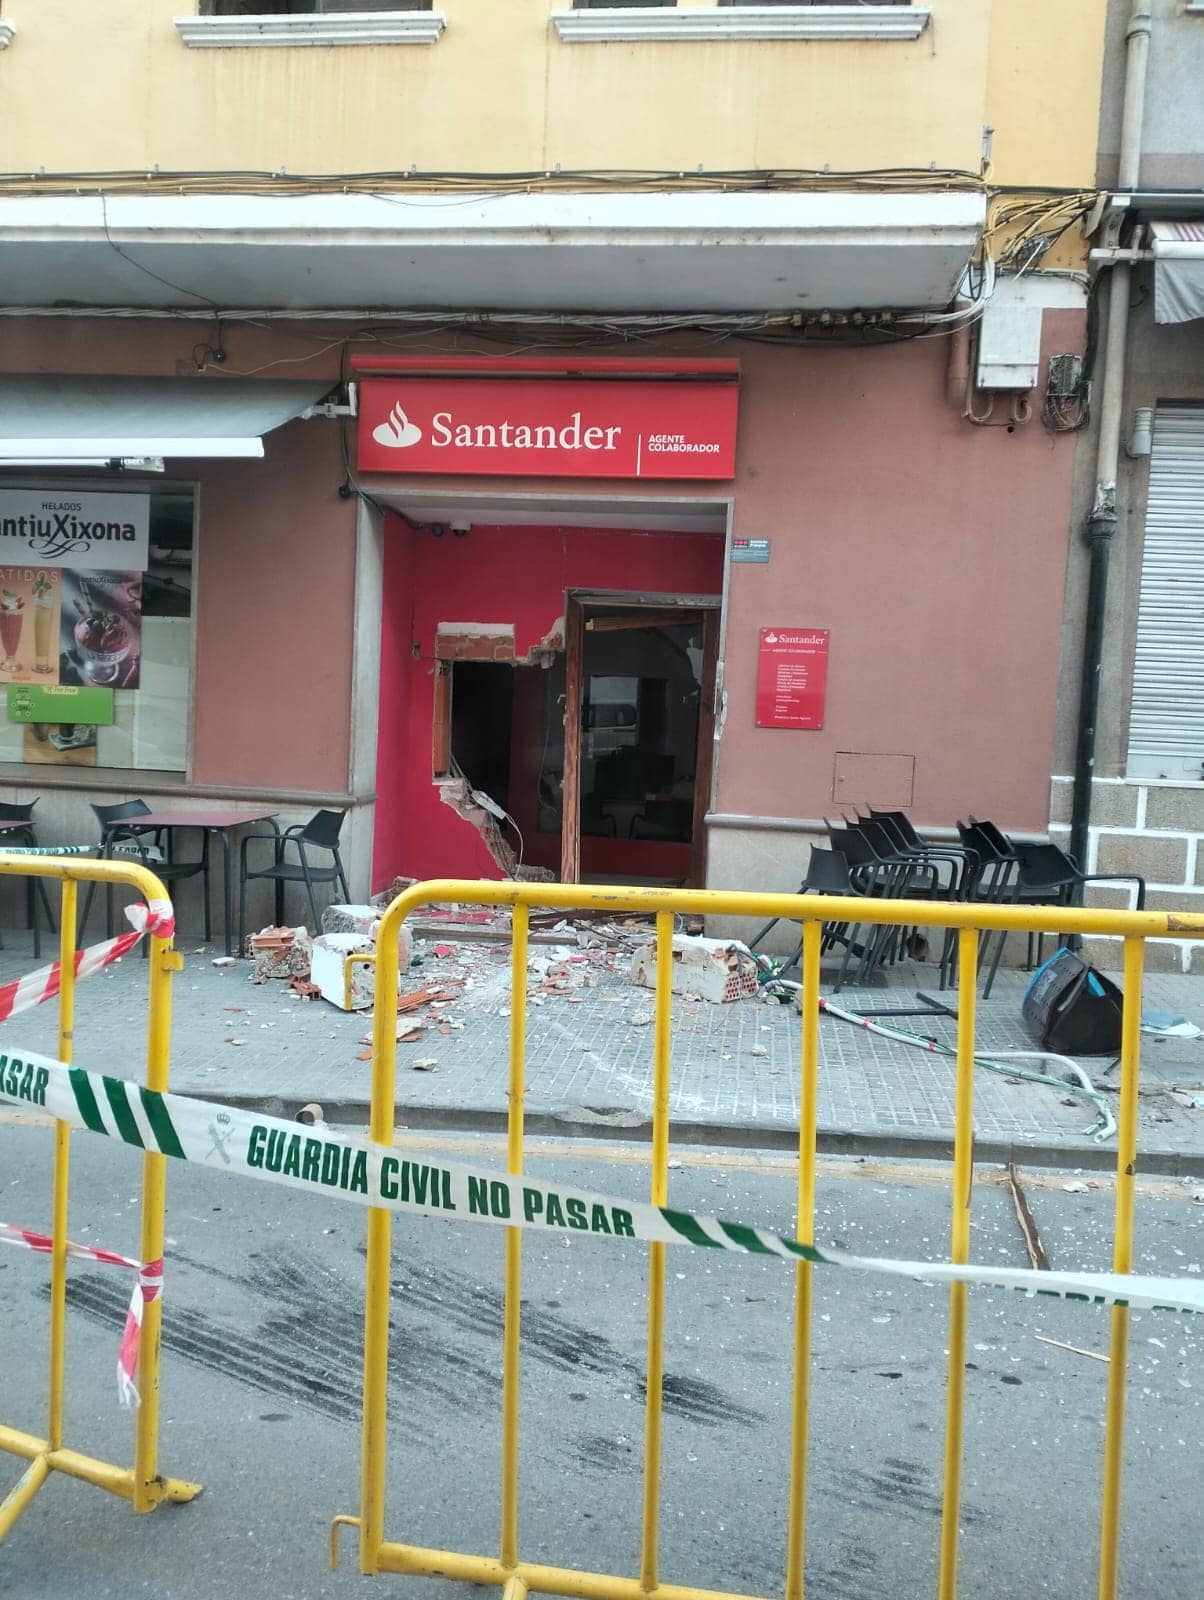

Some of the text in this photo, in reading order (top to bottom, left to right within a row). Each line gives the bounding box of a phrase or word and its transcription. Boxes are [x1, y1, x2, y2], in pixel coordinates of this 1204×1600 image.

[431, 411, 622, 450] Santander
[648, 434, 685, 444] AGENTE
[648, 443, 720, 453] COLABORADOR
[41, 502, 82, 511] HELADOS
[0, 513, 136, 549] ntiuXixona
[778, 634, 825, 645] Santander
[246, 1124, 636, 1238] GUARDIA CIVIL NO PASAR
